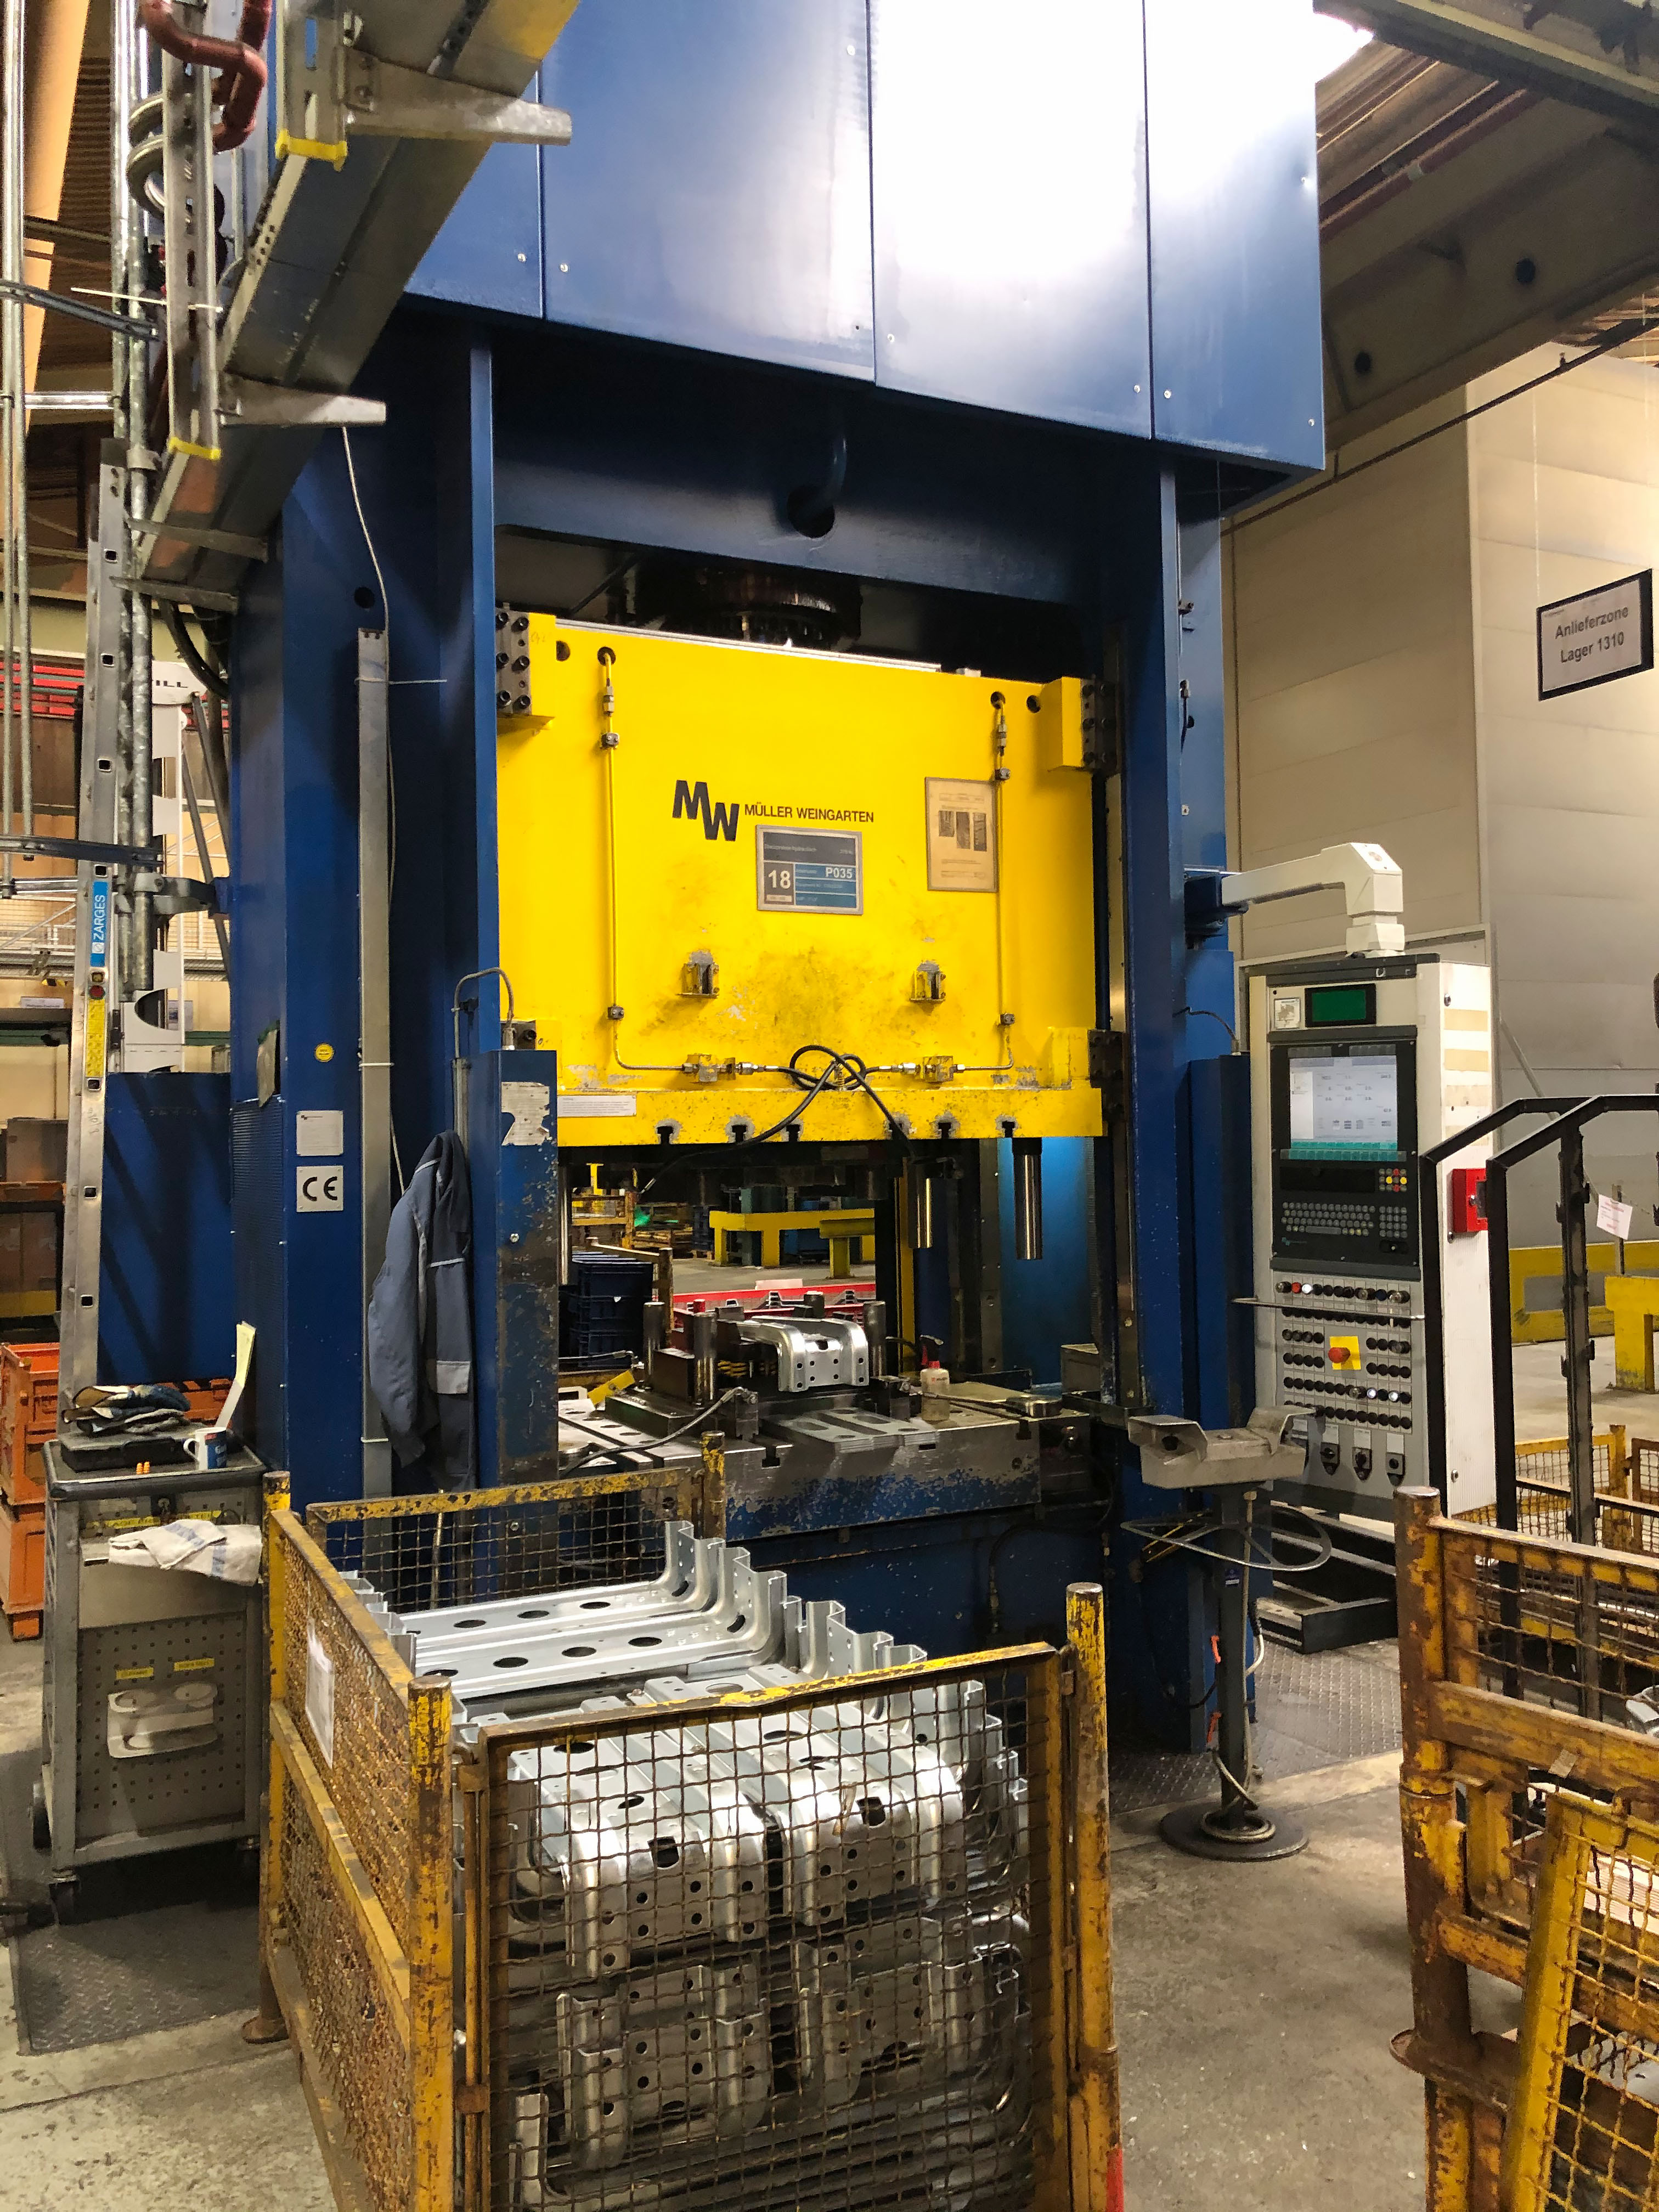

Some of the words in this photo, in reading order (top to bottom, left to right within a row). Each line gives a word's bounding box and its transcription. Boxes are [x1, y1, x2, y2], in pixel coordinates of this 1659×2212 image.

[1555, 606, 1628, 639] Anlieferzone
[1560, 642, 1594, 663] Lager
[1597, 631, 1624, 652] 1310
[672, 779, 740, 842] MW
[744, 802, 793, 819] MÜLLER
[796, 806, 874, 823] WEINGARTEN
[768, 869, 791, 889] 18
[825, 867, 853, 879] P035
[93, 894, 106, 941] ZARGES
[302, 1176, 338, 1202] CE
